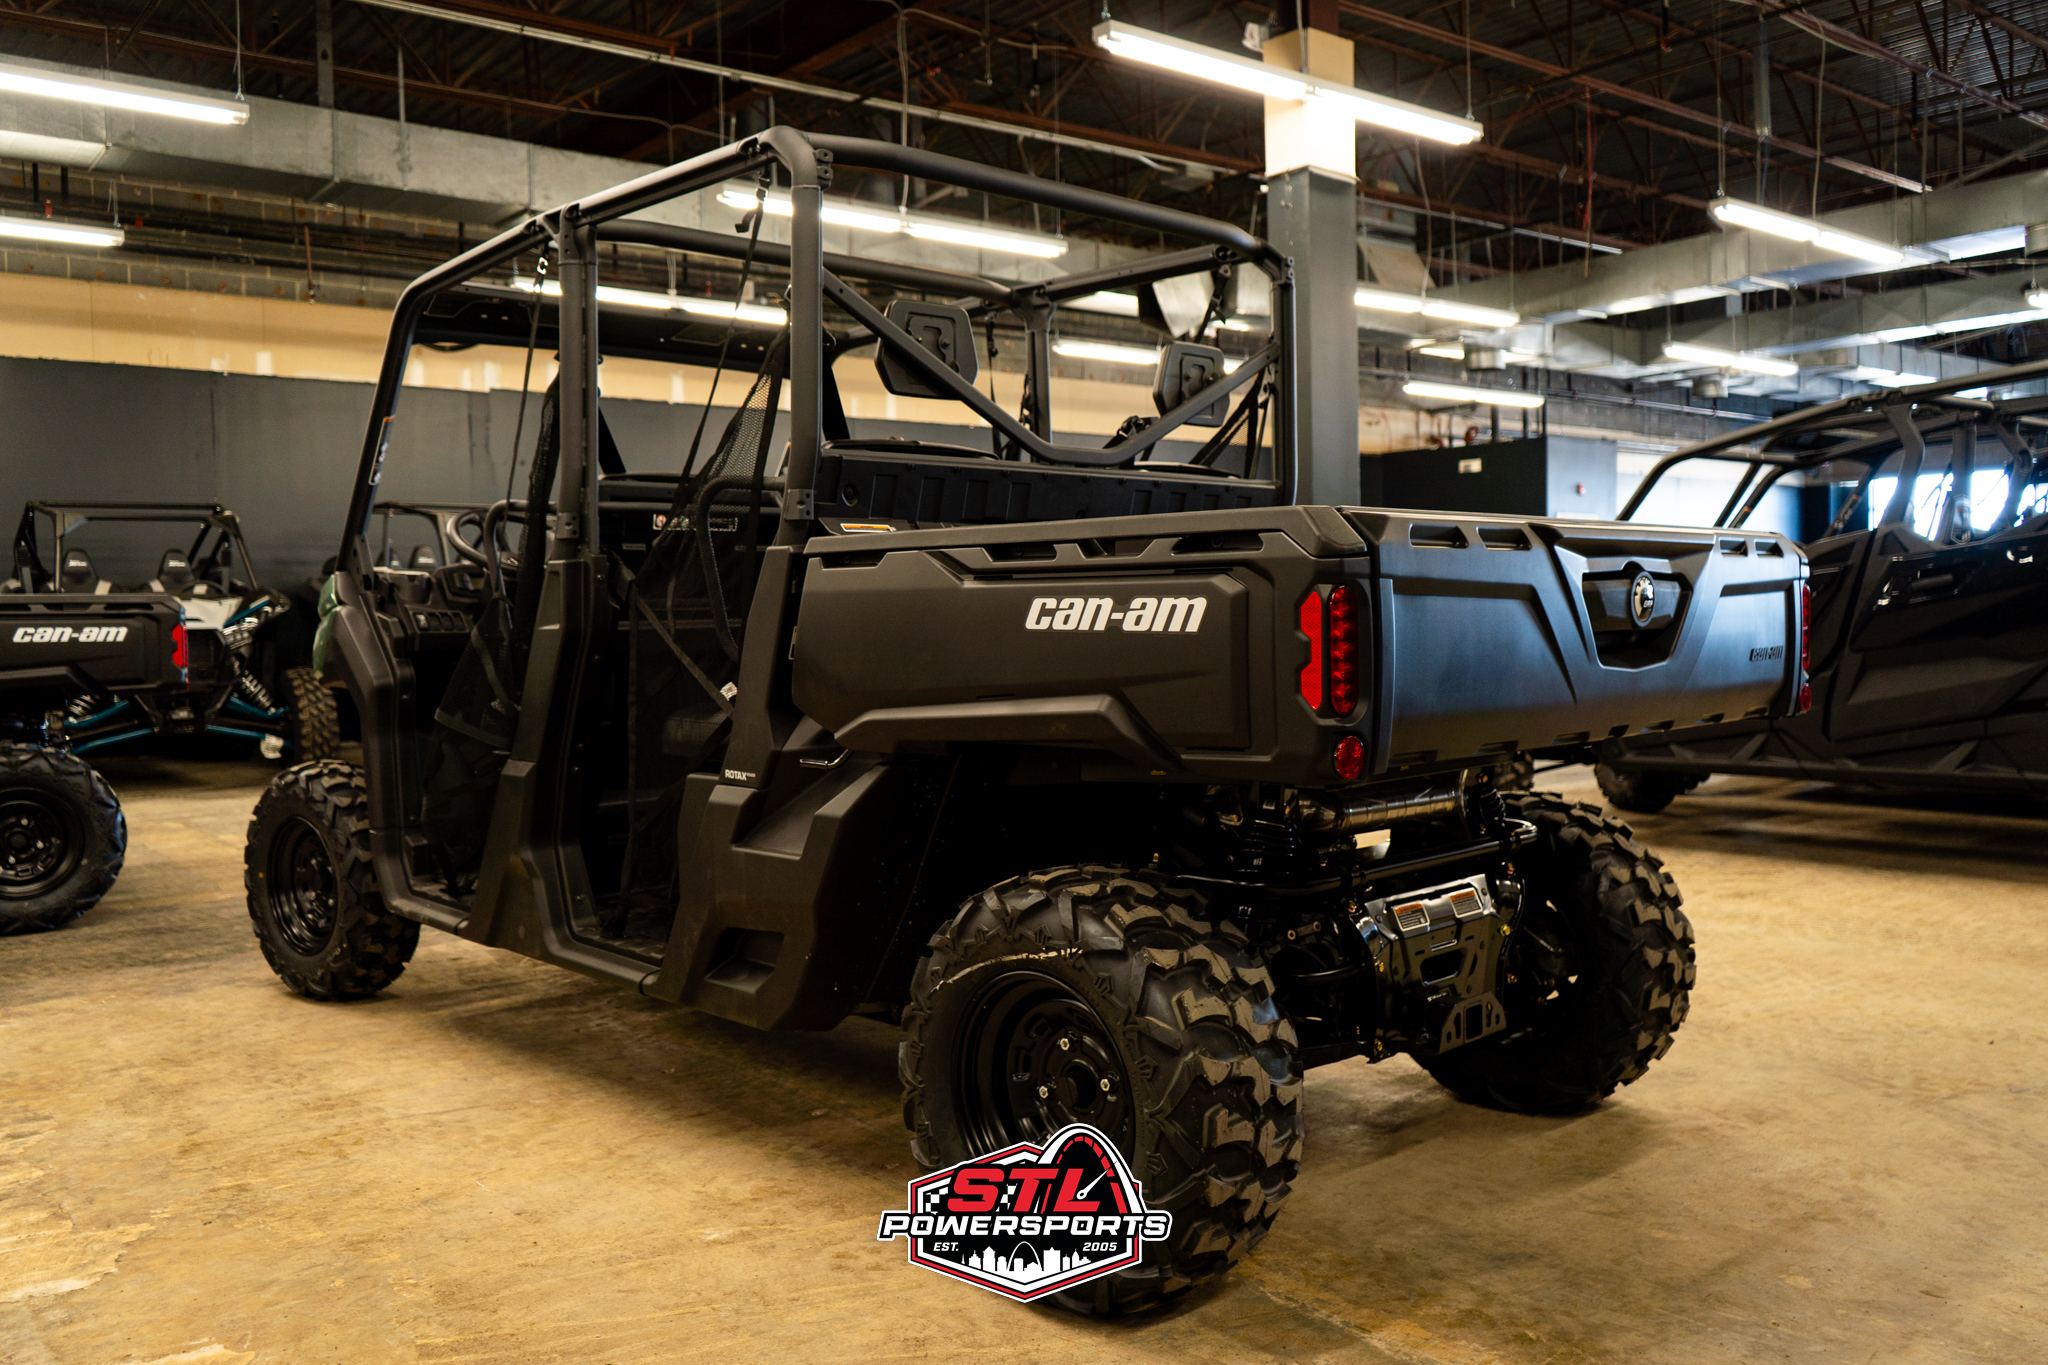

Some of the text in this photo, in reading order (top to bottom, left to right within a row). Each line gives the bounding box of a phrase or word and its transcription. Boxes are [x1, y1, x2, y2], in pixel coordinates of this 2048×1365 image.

[1025, 597, 1207, 631] can-am
[13, 626, 128, 643] can-am
[725, 769, 747, 780] ROTAX
